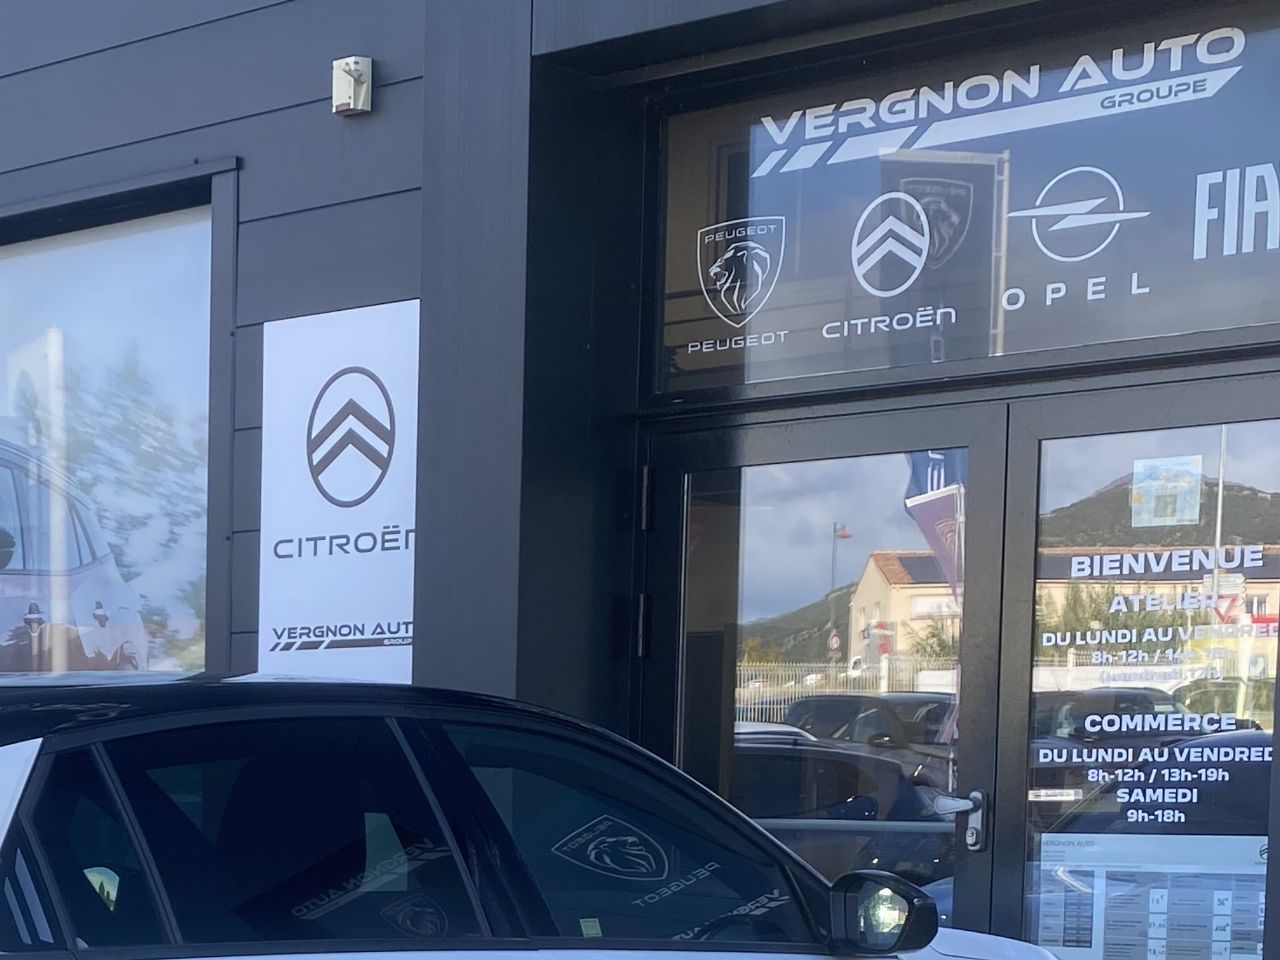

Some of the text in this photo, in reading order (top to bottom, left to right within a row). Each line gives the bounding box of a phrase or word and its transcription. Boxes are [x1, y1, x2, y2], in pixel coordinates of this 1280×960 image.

[761, 27, 1246, 145] VERGNON AUTO
[1100, 79, 1208, 110] GROUPE
[705, 224, 778, 244] PEUGEOT
[1001, 272, 1151, 311] OPEL
[688, 331, 790, 354] PEUGEOT
[1070, 545, 1264, 577] BIENVENUE
[1109, 591, 1218, 613] ATELIER
[272, 623, 365, 640] VERGNON
[1042, 632, 1070, 647] DU
[1075, 629, 1137, 645] LUNDI
[1142, 627, 1173, 642] AU
[1091, 650, 1149, 664] 8h-12h
[1084, 713, 1236, 732] COMMERCE
[1039, 749, 1067, 763] DU
[1072, 748, 1133, 763] LUNDI
[1138, 747, 1169, 763] AU
[1087, 767, 1230, 783] 8h-12h / 13h-19h
[1116, 788, 1198, 803] SAMEDI
[1127, 809, 1186, 823] 9h-18h
